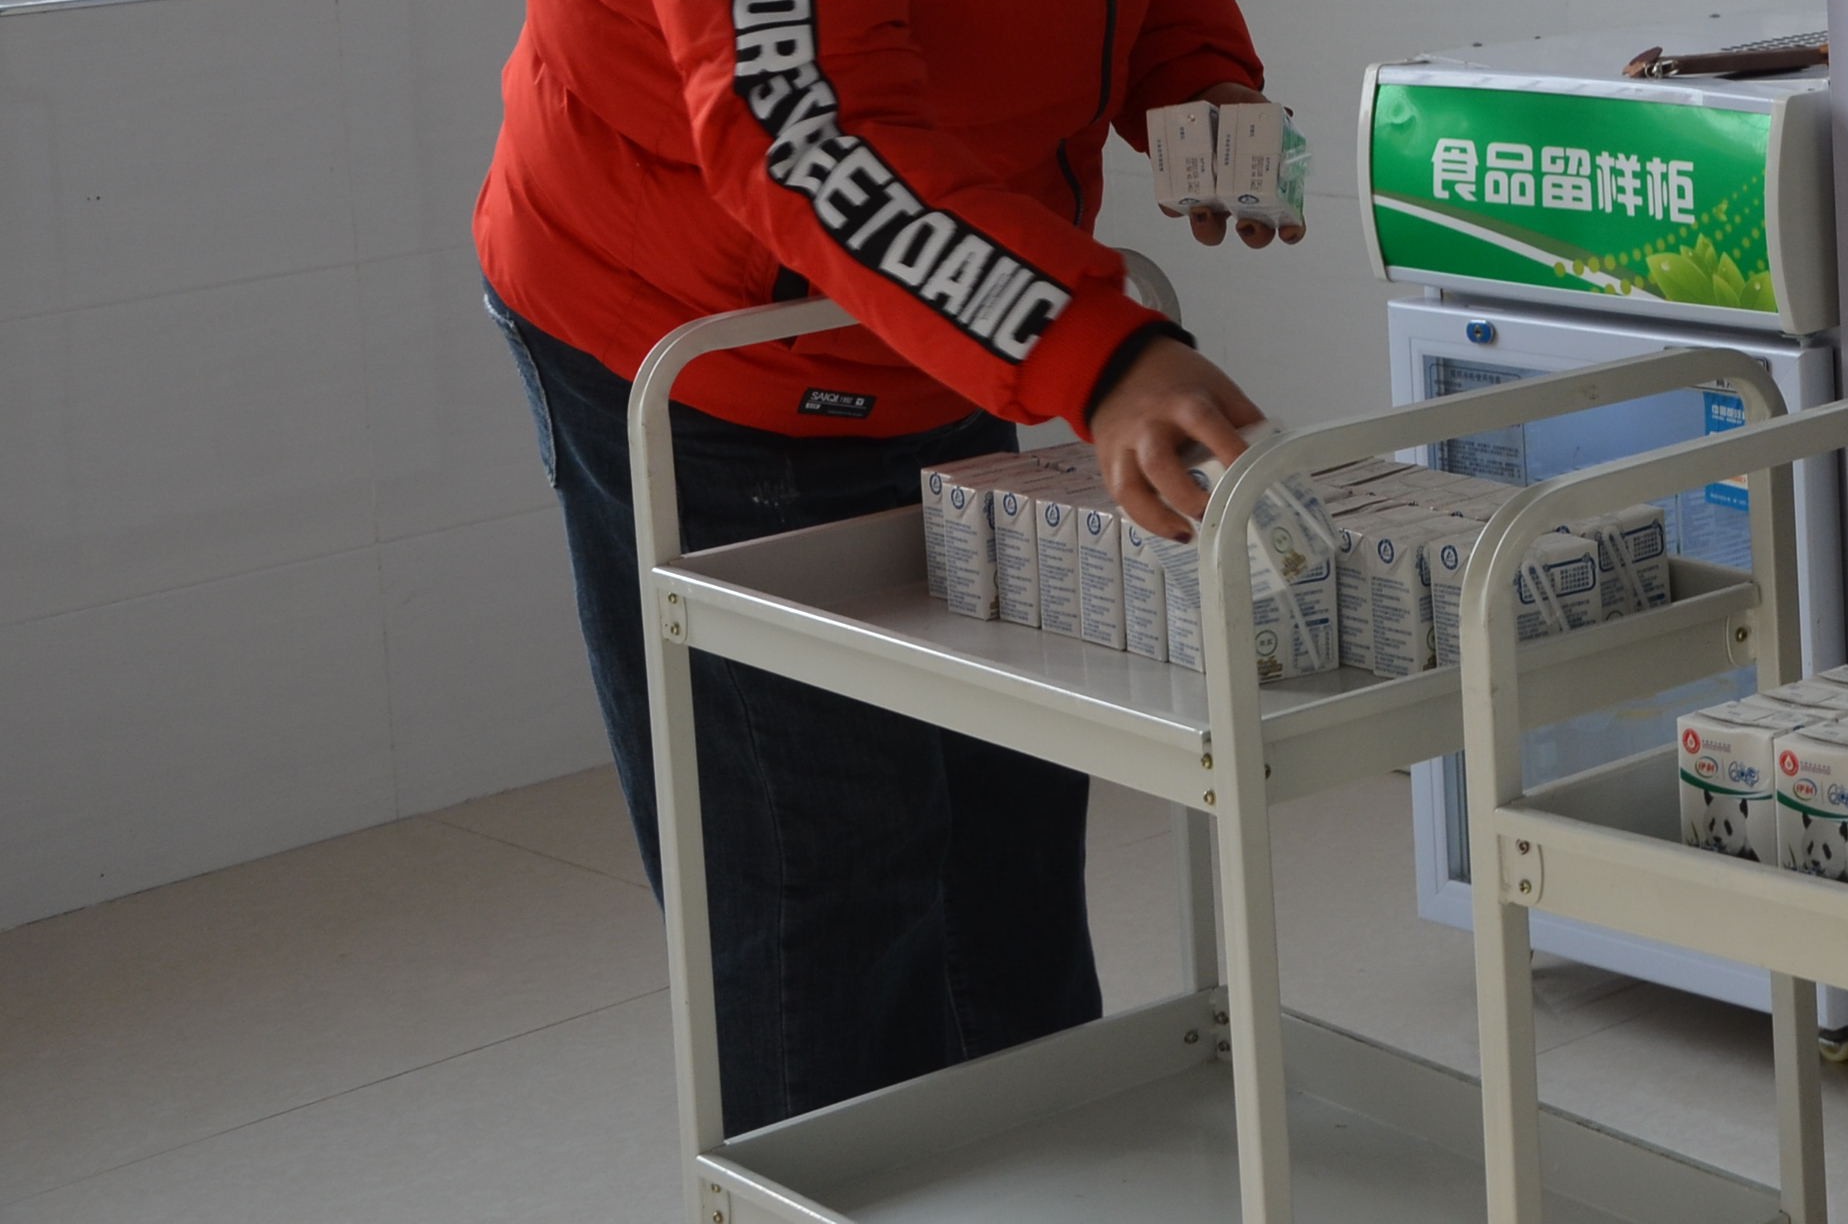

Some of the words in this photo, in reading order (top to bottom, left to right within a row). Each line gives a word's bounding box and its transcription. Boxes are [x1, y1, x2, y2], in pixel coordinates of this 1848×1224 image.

[1431, 137, 1696, 225] 食品留样柜
